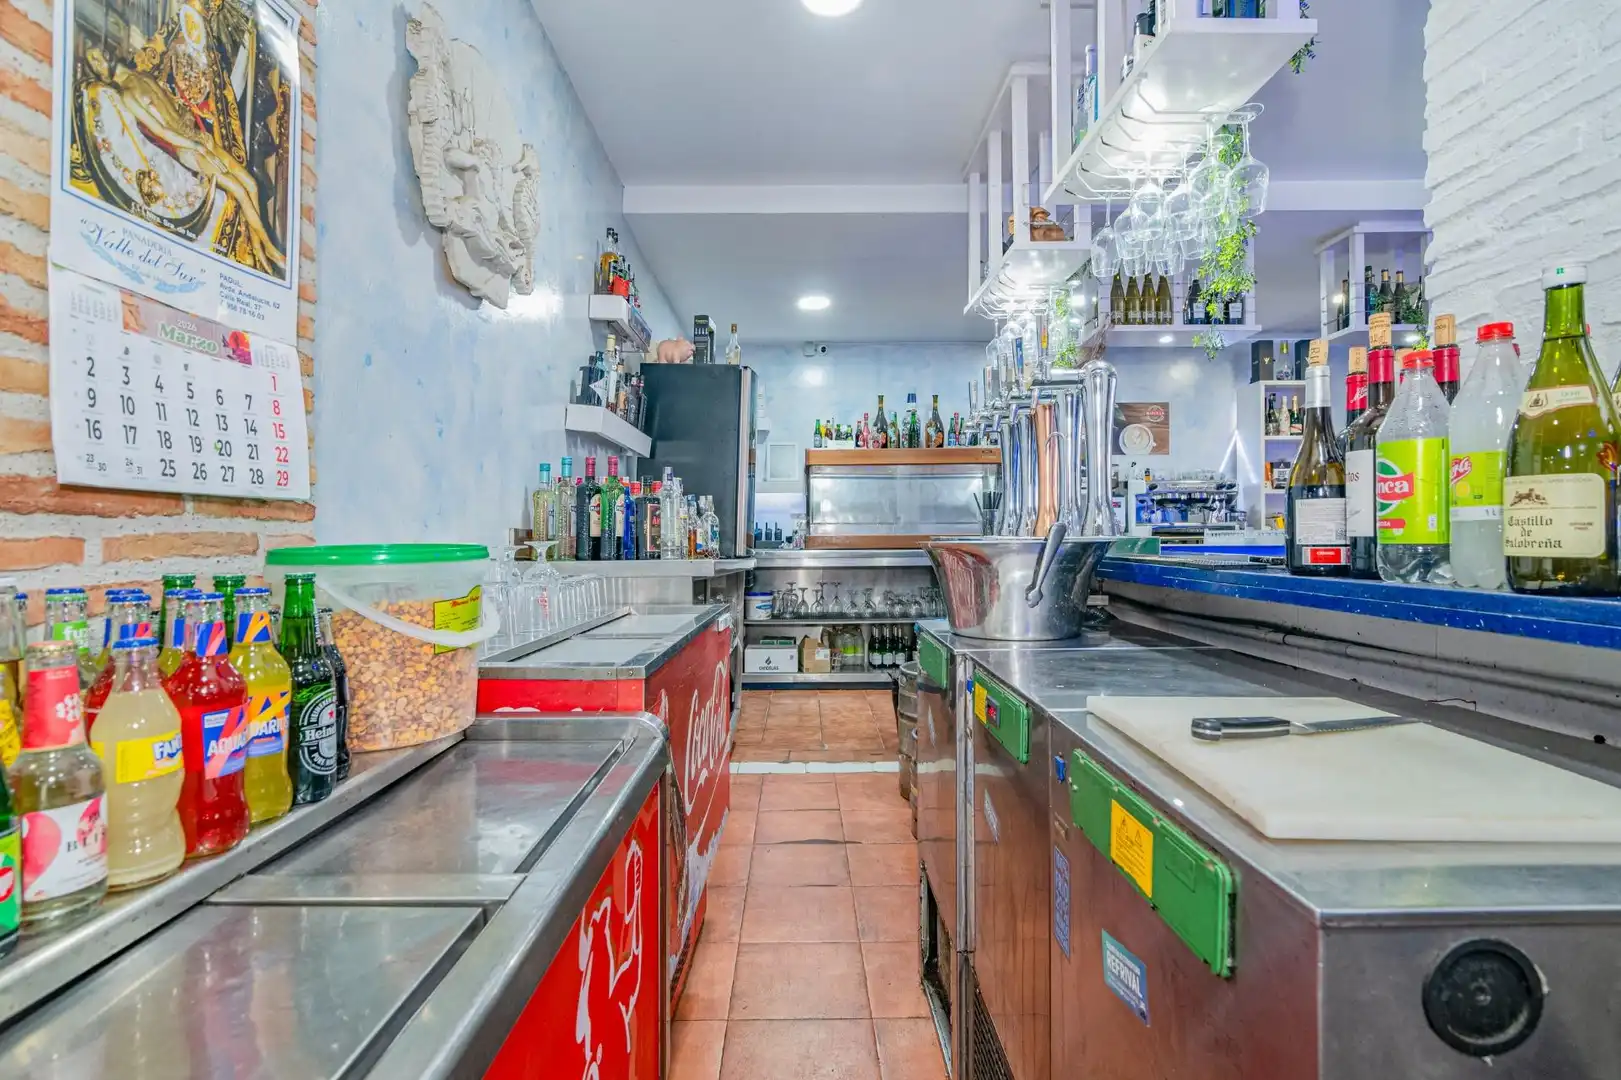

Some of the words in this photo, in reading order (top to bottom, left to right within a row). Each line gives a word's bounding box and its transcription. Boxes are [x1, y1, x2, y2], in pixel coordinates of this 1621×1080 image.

[138, 249, 163, 268] del
[158, 323, 219, 353] Marzo
[86, 357, 96, 377] 2
[122, 366, 130, 385] 3
[155, 375, 164, 393] 4
[187, 383, 194, 400] 5
[216, 390, 224, 406] 6
[245, 394, 252, 410] 7
[271, 376, 277, 391] 1
[87, 388, 96, 408] 9
[120, 395, 135, 416] 10
[156, 402, 167, 422] 11
[186, 408, 200, 427] 12
[216, 414, 228, 432] 13
[244, 419, 257, 436] 14
[273, 400, 280, 415] 8
[85, 418, 102, 440] 16
[123, 425, 137, 445] 17
[157, 430, 172, 450] 18
[189, 435, 202, 453] 19
[217, 440, 232, 458] 20
[248, 444, 259, 460] 21
[273, 423, 286, 439] 15
[86, 454, 94, 463] 23
[125, 458, 133, 466] 24
[160, 458, 177, 477] 25
[192, 462, 208, 481] 26
[222, 466, 235, 483] 27
[249, 469, 264, 485] 28
[275, 447, 289, 463] 22
[98, 462, 107, 472] 30
[137, 466, 143, 475] 31
[276, 470, 288, 487] 29
[1508, 515, 1553, 527] Castillo
[1520, 526, 1533, 537] de
